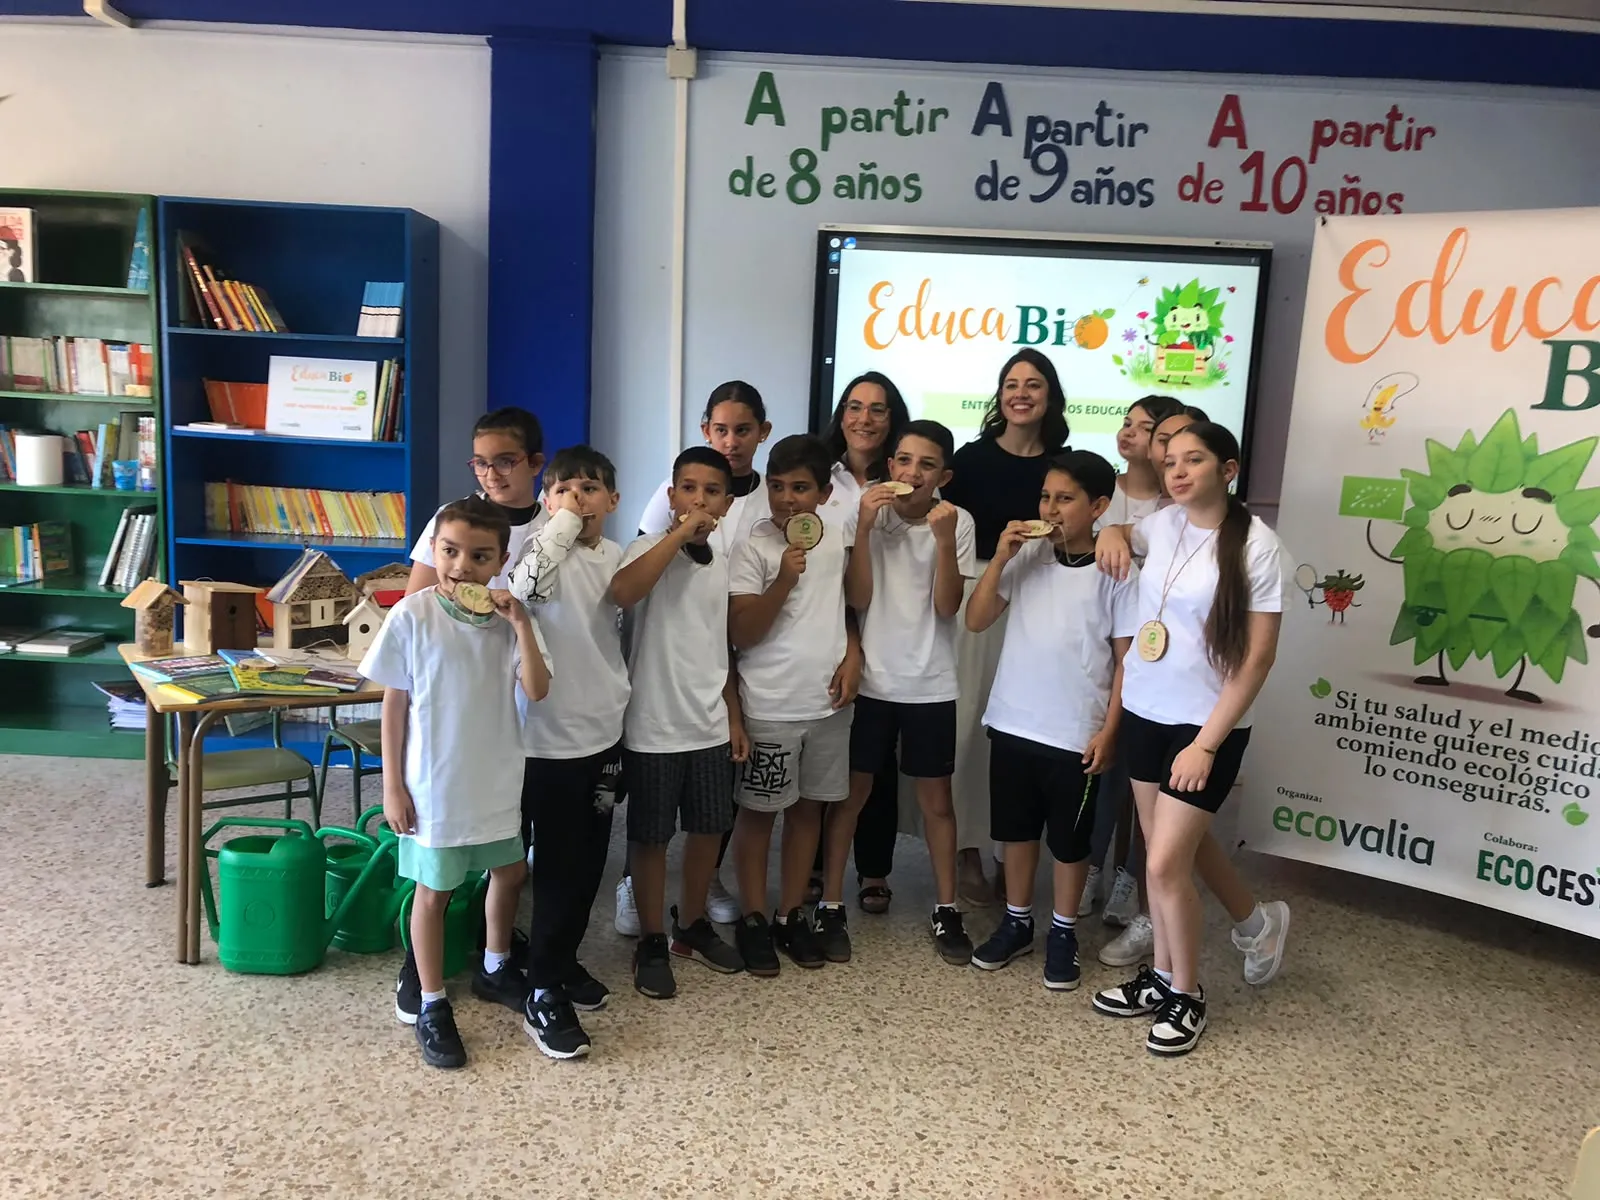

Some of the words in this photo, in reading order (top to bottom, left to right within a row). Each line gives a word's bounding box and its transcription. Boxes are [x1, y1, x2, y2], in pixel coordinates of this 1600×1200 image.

[745, 71, 786, 127] A
[821, 90, 949, 152] partir
[971, 81, 1013, 138] A
[1023, 100, 1149, 160] partir
[1207, 94, 1249, 150] A
[1308, 104, 1437, 165] partir
[728, 155, 777, 198] de
[786, 147, 822, 205] 8
[833, 161, 923, 203] años
[974, 159, 1021, 201] de
[1029, 143, 1069, 203] 9
[1070, 166, 1155, 208] años
[1177, 161, 1225, 204] de
[1239, 150, 1308, 215] 10
[1314, 173, 1405, 215] años
[961, 400, 997, 411] ENTR
[1335, 690, 1358, 711] Si
[1364, 698, 1388, 716] tu
[1394, 703, 1462, 730] salud
[1466, 717, 1484, 738] y
[1489, 718, 1514, 739] el
[748, 750, 792, 771] NEXT
[1314, 711, 1428, 745] ambiente
[1433, 733, 1530, 764] quieres
[1536, 753, 1600, 780] cuid
[1336, 736, 1457, 771] comiendo
[1463, 761, 1590, 799] ecológico
[741, 768, 792, 789] LEVEL
[1276, 785, 1323, 804] Organiza:
[1364, 755, 1387, 778] lo
[1392, 768, 1551, 814] conseguirás.
[1272, 805, 1436, 866] ecovalia
[1483, 832, 1539, 853] Colabora:
[1475, 848, 1600, 907] ECOCES
